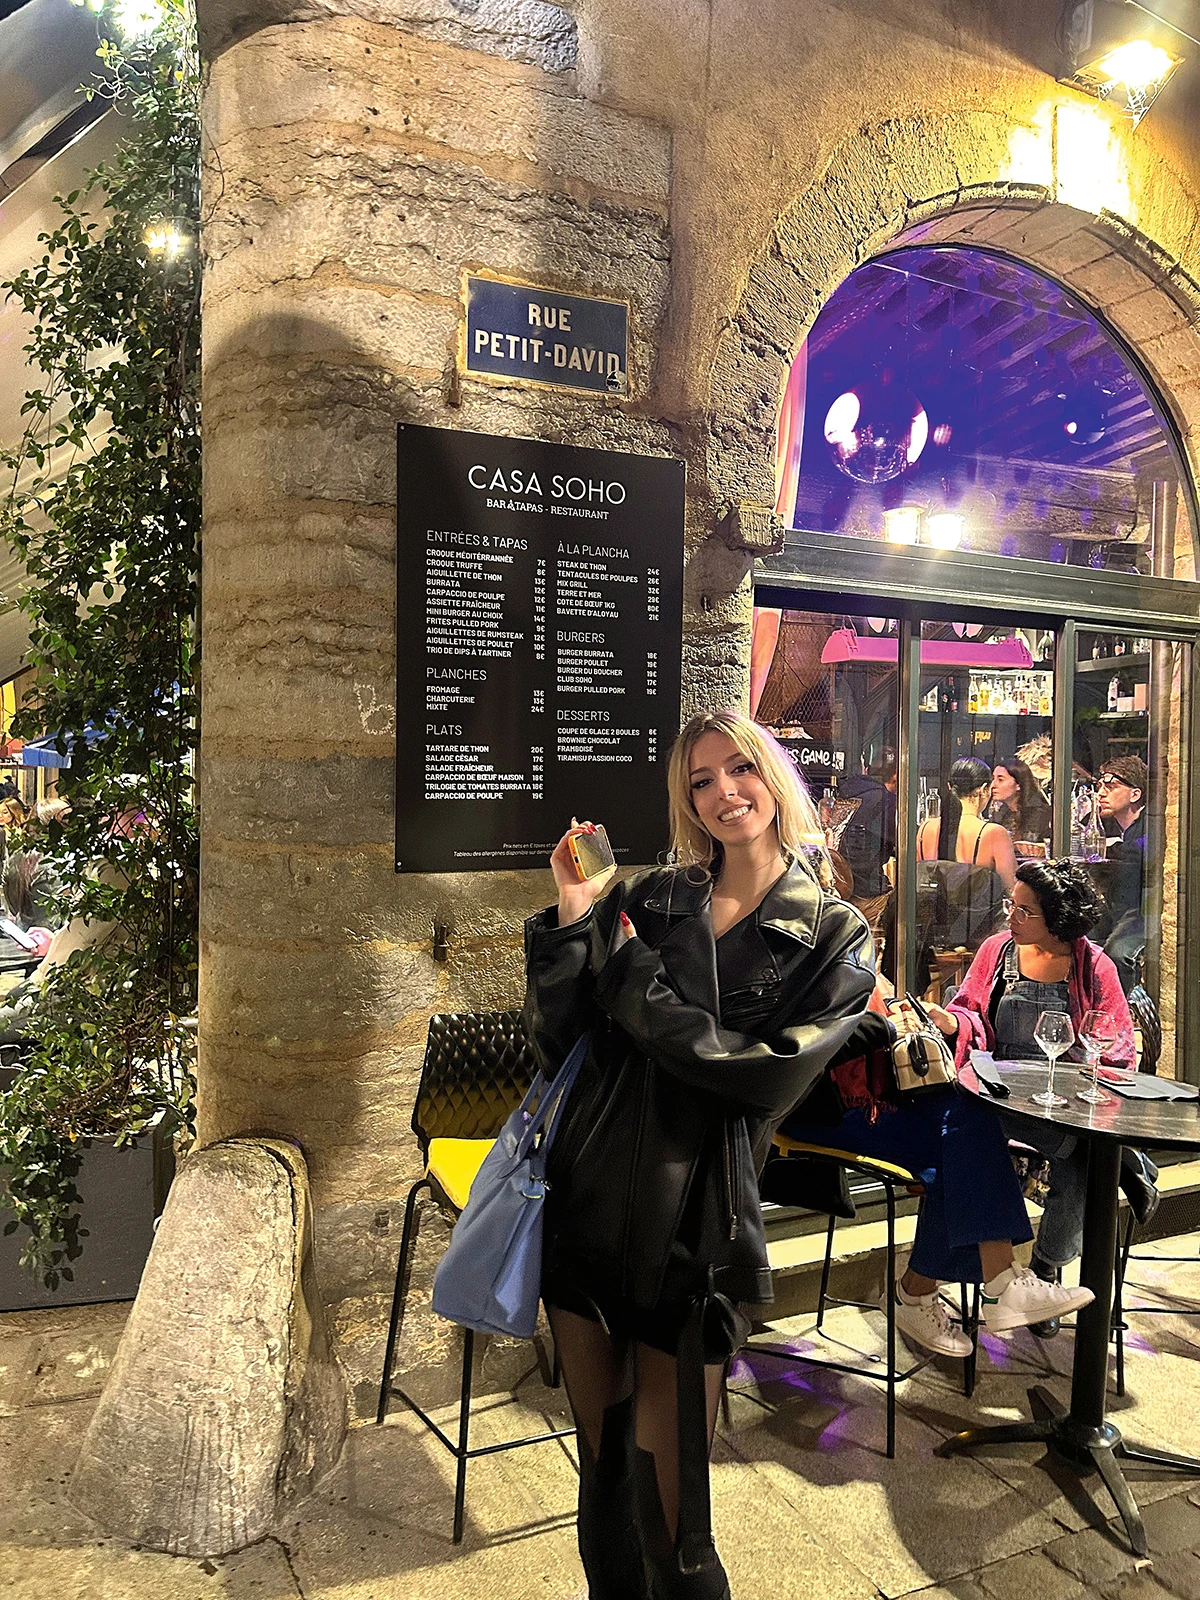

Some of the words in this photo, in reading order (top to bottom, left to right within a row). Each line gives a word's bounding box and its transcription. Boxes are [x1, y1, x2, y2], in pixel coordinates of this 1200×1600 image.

[528, 303, 571, 331] RUE
[475, 329, 620, 374] PETIT-DAVID
[468, 465, 543, 496] CASA
[551, 475, 626, 504] SOHO
[551, 506, 609, 519] RESTAURANT
[427, 530, 480, 546] ENTRÉES
[482, 536, 490, 546] &
[493, 536, 528, 550] TAPAS
[426, 549, 454, 558] CROQUE
[558, 541, 564, 553] À
[567, 544, 579, 554] LA
[582, 545, 629, 559] PLANCHA
[426, 559, 454, 568] CROQUE
[456, 561, 483, 570] TRUFFE
[557, 561, 578, 569] STEAK
[427, 569, 471, 579] AIGUILLETTE
[558, 570, 599, 580] TENTACULES
[610, 575, 638, 583] POULPES
[427, 579, 460, 587] BURRATA
[426, 588, 466, 597] CARPACCIO
[479, 592, 505, 600] POULPE
[427, 598, 460, 606] ASSIETTE
[427, 628, 475, 637] AIGUILLETTES
[557, 631, 605, 643] BURGERS
[427, 637, 475, 646] AIGUILLETTES
[478, 649, 511, 657] TARTINER
[427, 667, 487, 680] PLANCHES
[426, 695, 475, 703] CHARCUTERIE
[557, 710, 610, 721] DESSERTS
[426, 724, 462, 736] PLATS
